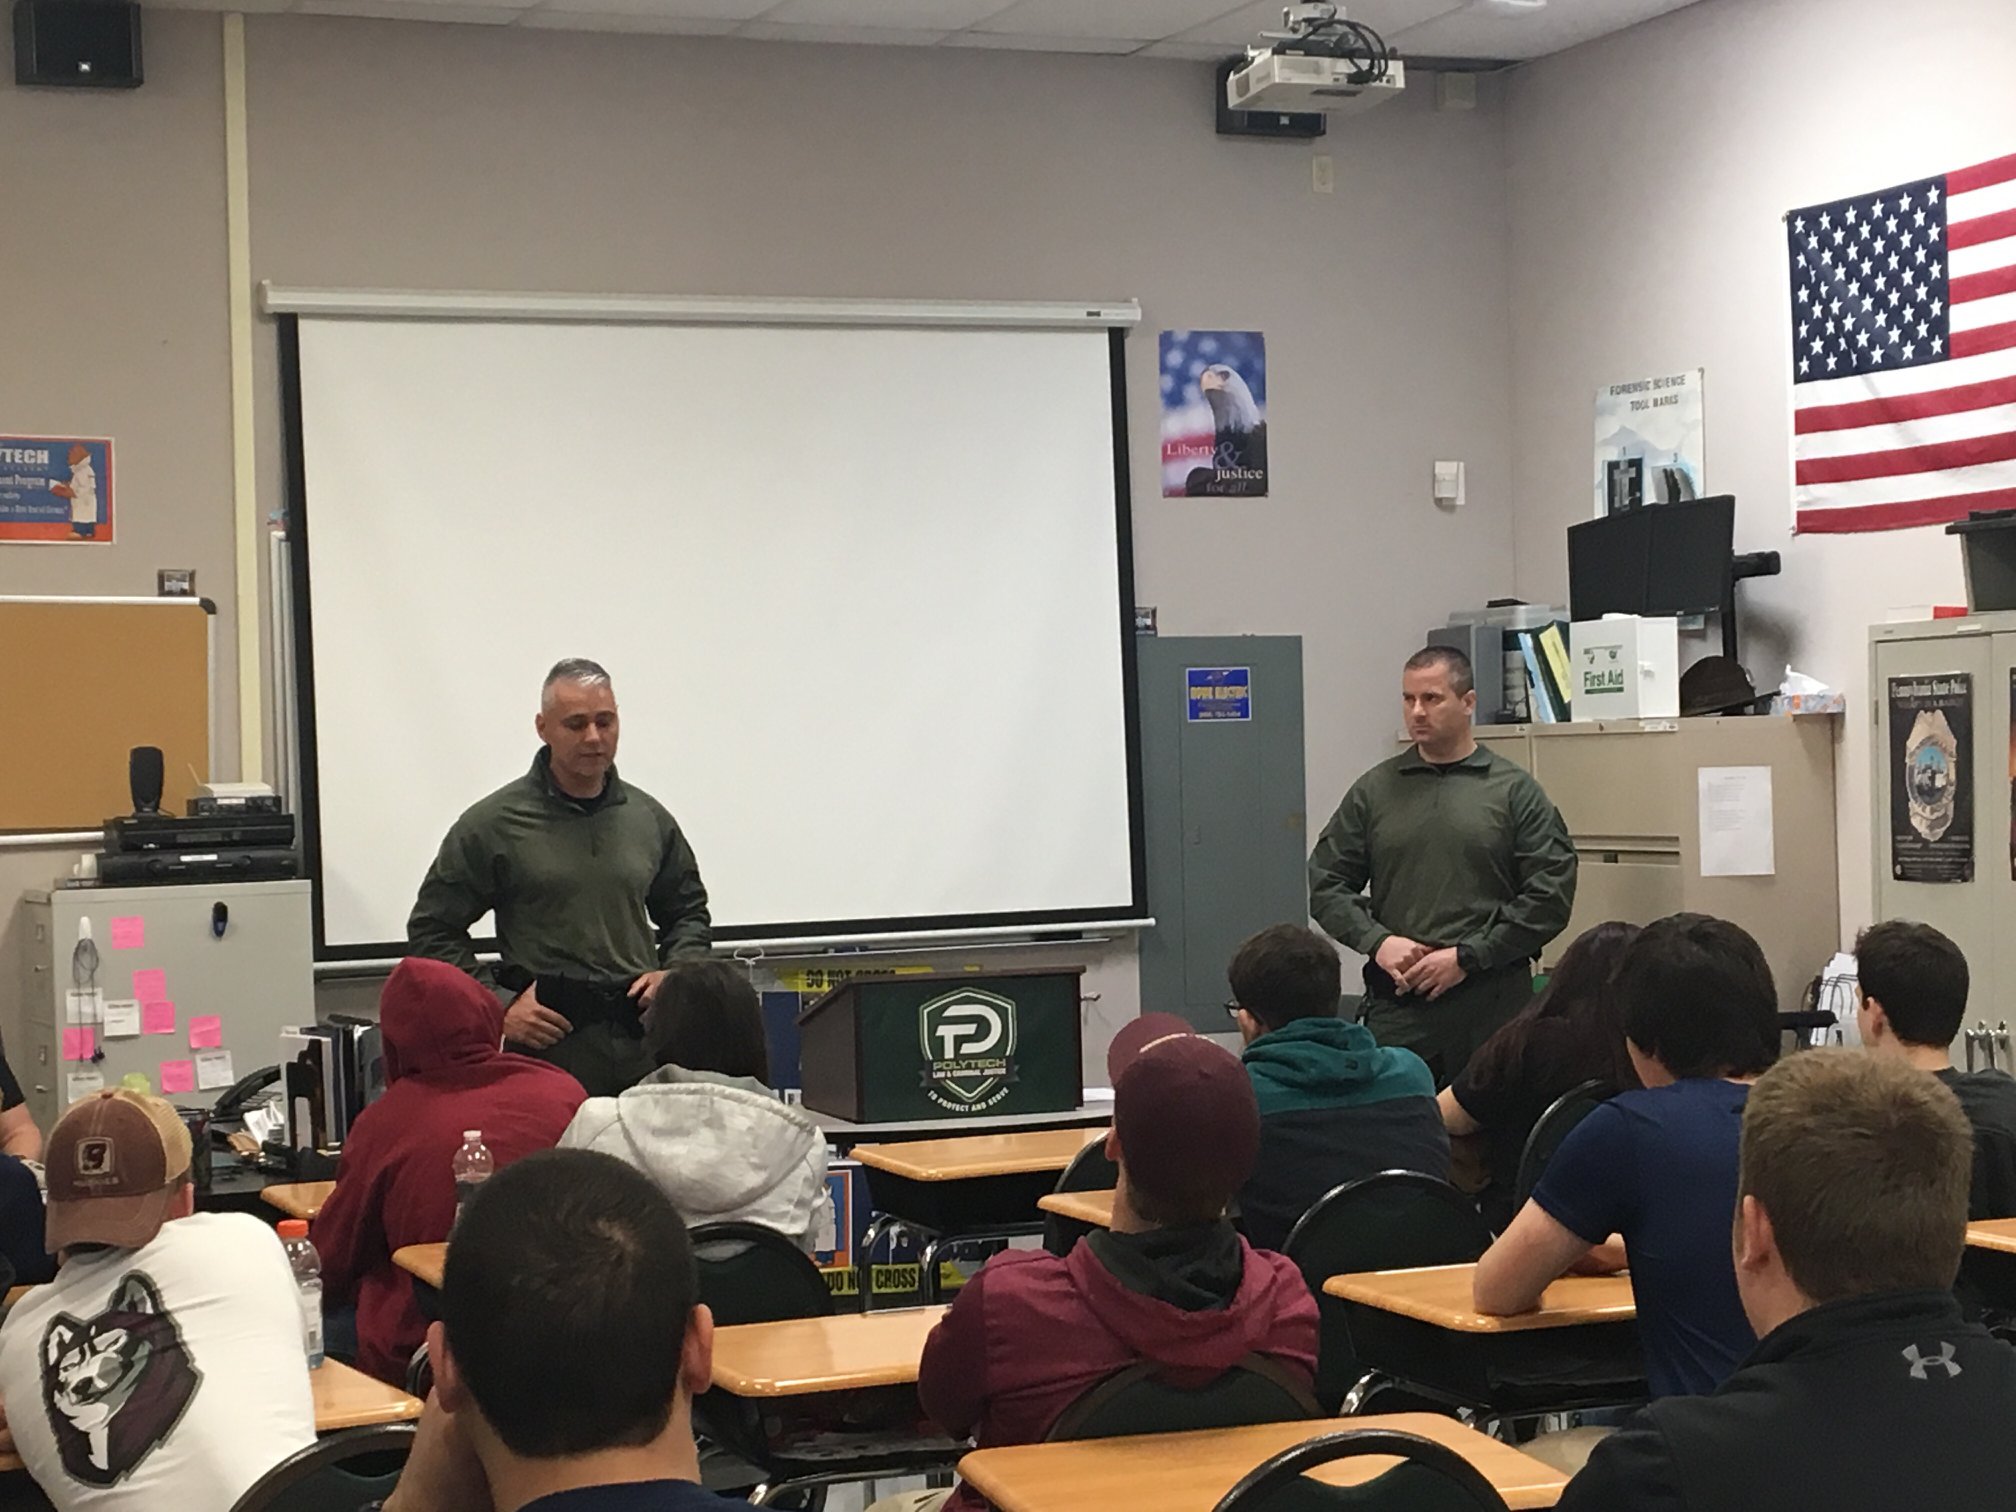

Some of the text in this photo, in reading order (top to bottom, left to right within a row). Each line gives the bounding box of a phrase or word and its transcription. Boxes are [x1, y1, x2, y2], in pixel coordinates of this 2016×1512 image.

[1609, 375, 1686, 396] FORENSIC SCIENCE
[1652, 395, 1679, 408] MARKS
[1166, 441, 1243, 470] Liberty &
[1215, 467, 1264, 482] justice
[1206, 481, 1247, 493] for all
[1583, 669, 1624, 688] First Aid
[932, 1058, 1007, 1070] POLYTECH
[927, 1086, 1010, 1112] TO PROTECT AND SERVE
[875, 1268, 916, 1290] CROSS
